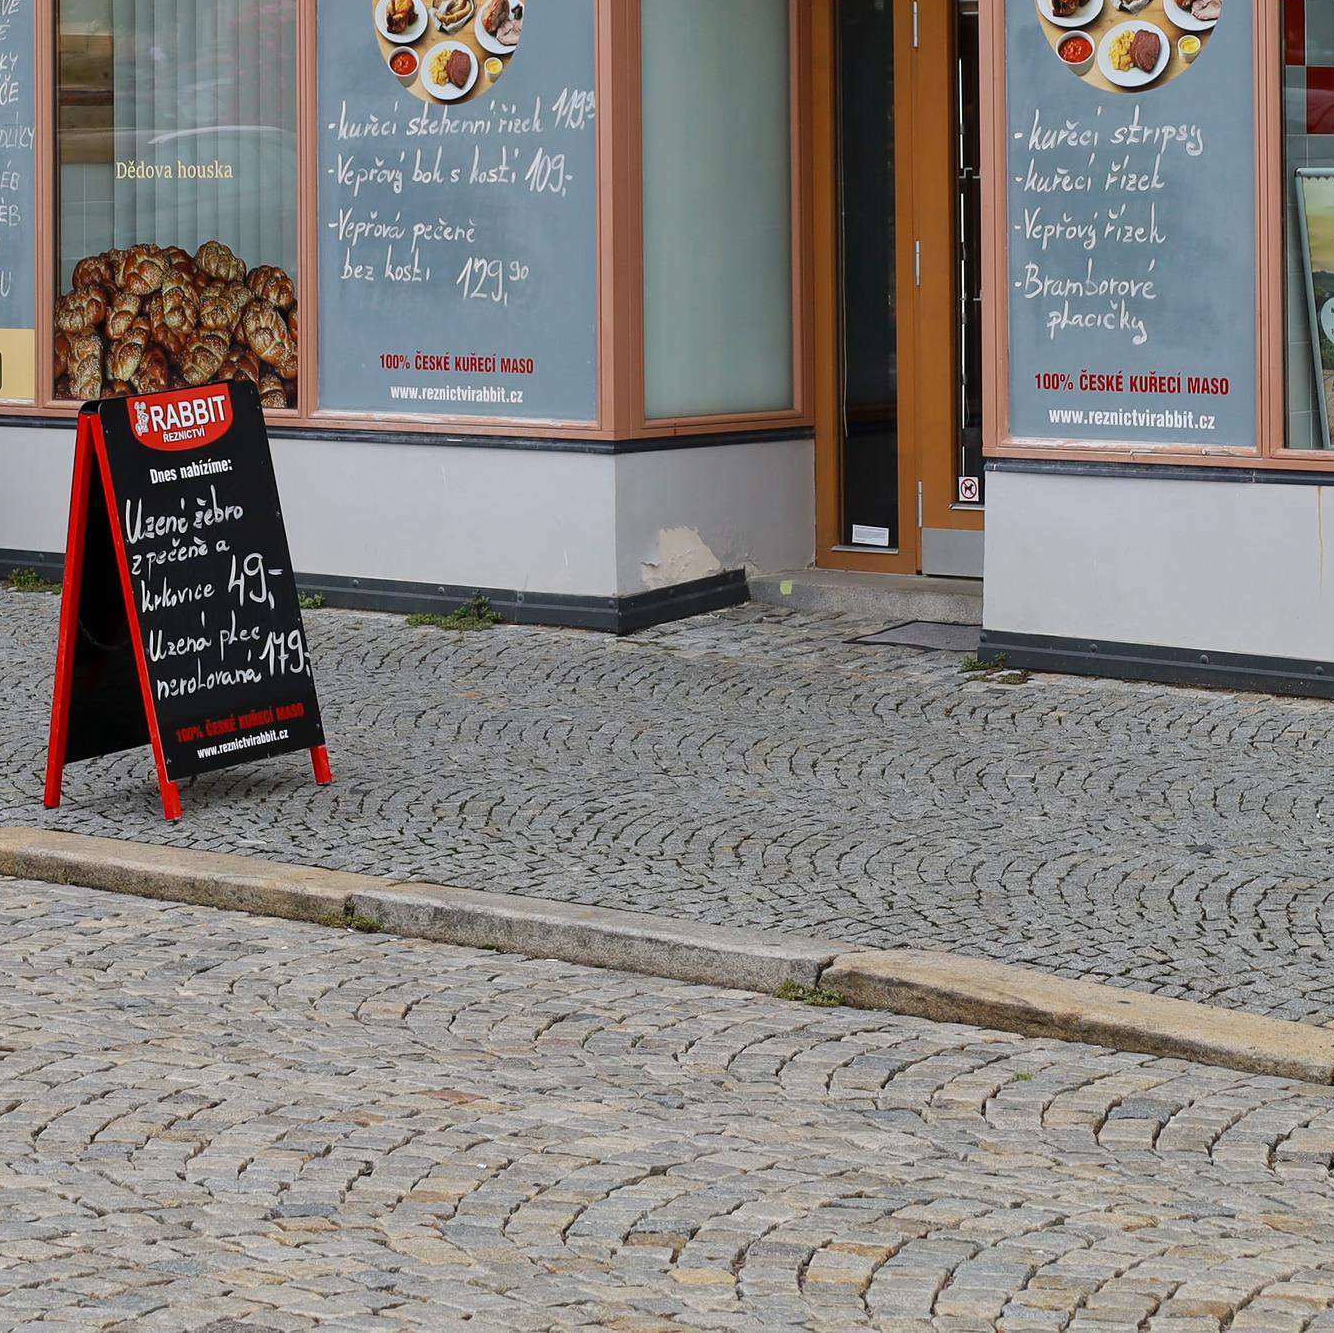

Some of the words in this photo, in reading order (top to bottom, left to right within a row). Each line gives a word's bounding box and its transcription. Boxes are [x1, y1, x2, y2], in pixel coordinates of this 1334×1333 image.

[1110, 104, 1204, 156] stripsy
[116, 160, 173, 179] Dědova
[177, 160, 234, 179] houska
[413, 146, 444, 183] bok
[450, 168, 460, 183] s
[470, 145, 520, 185] kosti
[1105, 153, 1165, 191] řízek
[411, 217, 476, 253] pečeně
[1104, 203, 1167, 244] řízek
[340, 245, 374, 282] bez
[385, 245, 430, 282] kosti
[1046, 299, 1148, 345] placičky
[379, 354, 411, 370] 100%
[415, 351, 451, 371] ČESKÉ
[455, 352, 497, 372] KUŘECÍ
[500, 357, 534, 374] MASO
[390, 385, 524, 403] www.reznictvirabbit.cz
[1035, 373, 1074, 391] 100%
[1079, 369, 1124, 392] ČESKÉ
[1129, 371, 1181, 394] KUŘECÍ
[1187, 377, 1230, 395] MASO
[150, 395, 226, 433] RABBIT
[1049, 408, 1216, 430] www.reznictvirabbit.cz
[163, 425, 206, 443] ŘEZNICTVÍ
[149, 467, 178, 485] Dnes
[180, 458, 233, 480] nabízíme:
[125, 496, 188, 545] Uzené
[193, 484, 244, 529] žebro
[146, 536, 208, 580] pečeně
[215, 539, 231, 553] a
[141, 576, 215, 613] krkovice
[147, 610, 212, 663] Uzená
[156, 648, 262, 701] nerolovaná
[176, 727, 204, 743] 100%
[205, 714, 237, 737] ČESKÉ
[239, 706, 274, 729] KUŘECÍ
[276, 702, 305, 721] MASO
[197, 728, 289, 759] www.reznictvirabbit.cz
